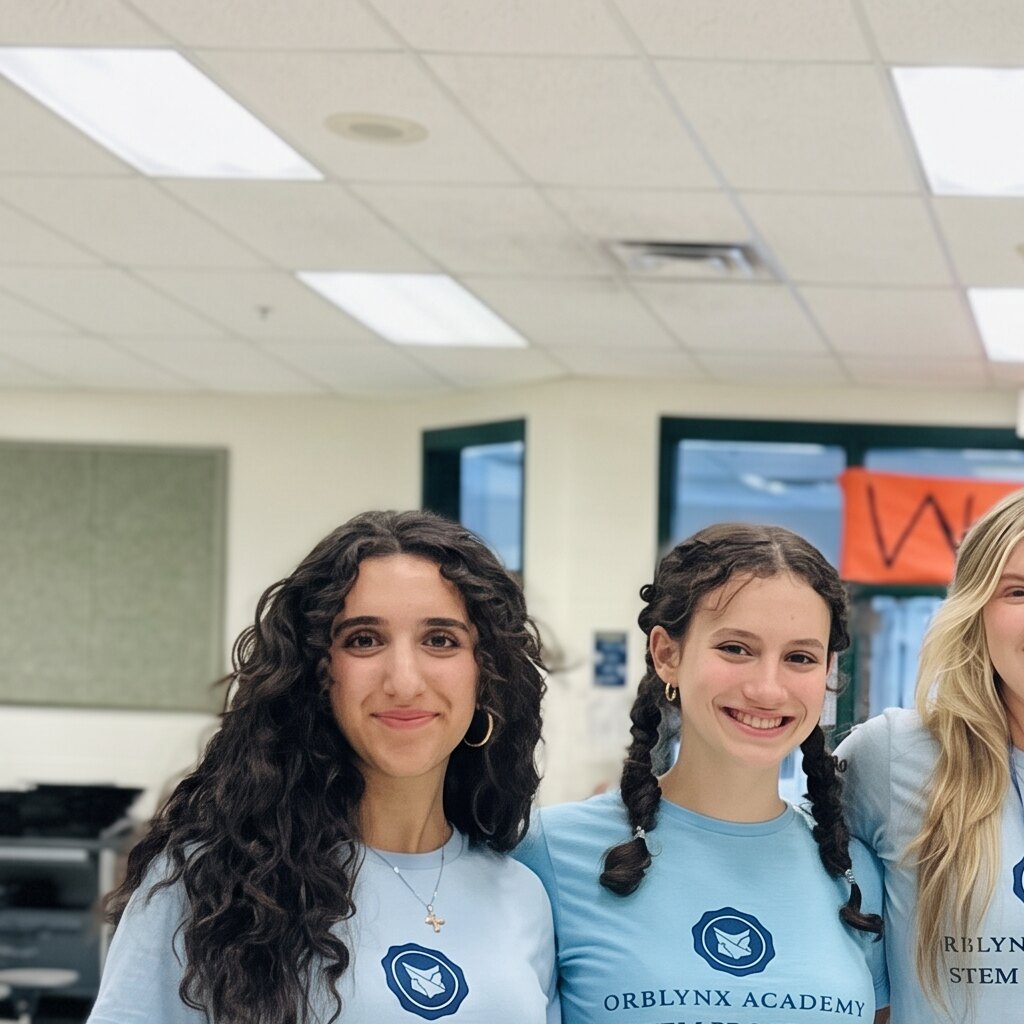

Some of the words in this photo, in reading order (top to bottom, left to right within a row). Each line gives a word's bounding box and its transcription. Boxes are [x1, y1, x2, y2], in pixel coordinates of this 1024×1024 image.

[949, 967, 1019, 985] STEM
[603, 989, 732, 1012] ORBLYNX
[742, 991, 866, 1018] ACADEMY
